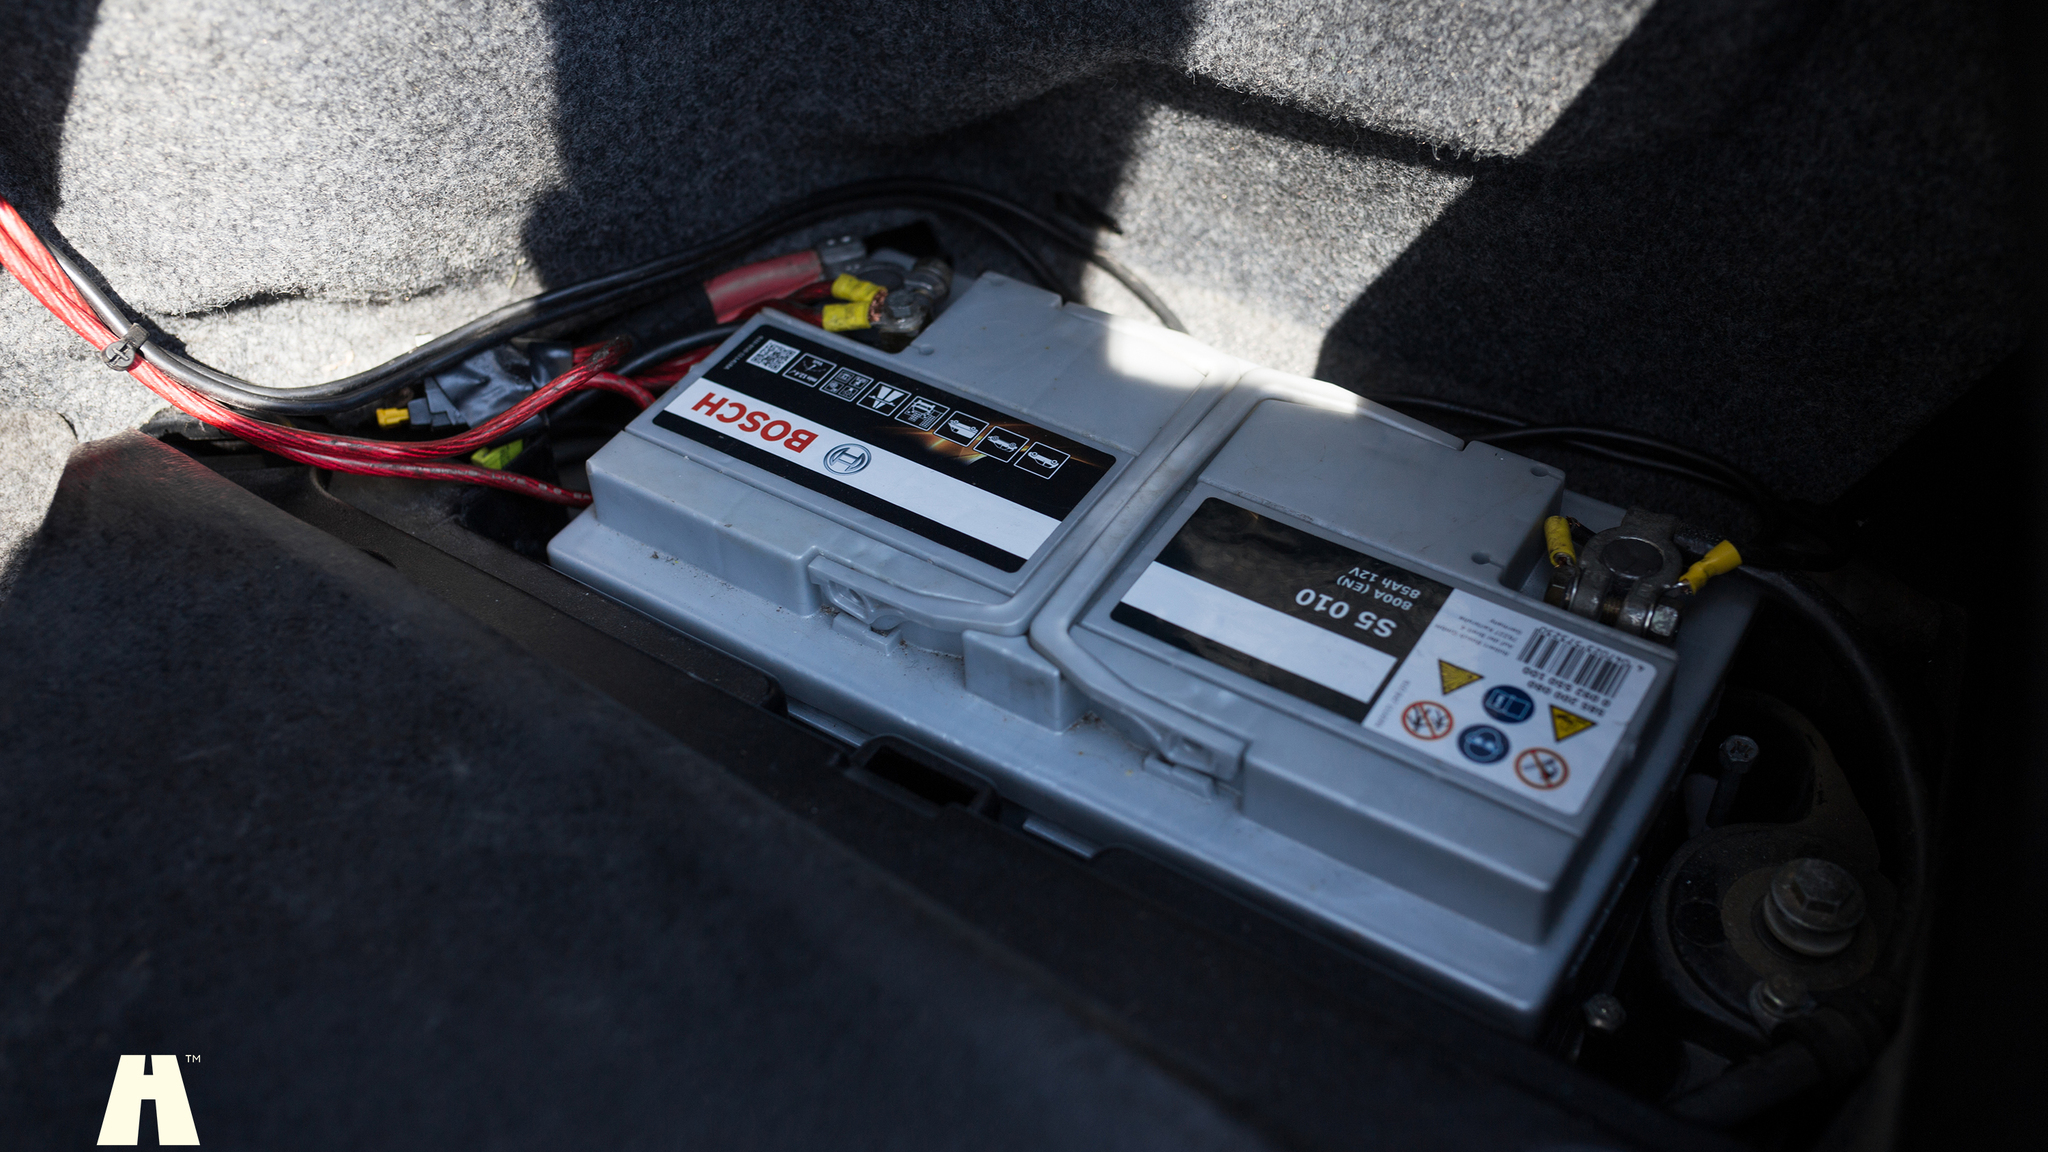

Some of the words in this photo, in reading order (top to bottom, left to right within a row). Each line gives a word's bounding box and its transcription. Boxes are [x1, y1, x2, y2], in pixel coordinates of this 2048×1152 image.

[691, 392, 819, 453] BOSCH
[1336, 575, 1370, 594] (EN)
[1348, 567, 1379, 582] 12V
[1381, 577, 1422, 599] 85Ah
[1295, 588, 1350, 619] 010
[1373, 589, 1413, 610] 800A
[1353, 611, 1397, 638] S5
[1522, 666, 1546, 680] 100
